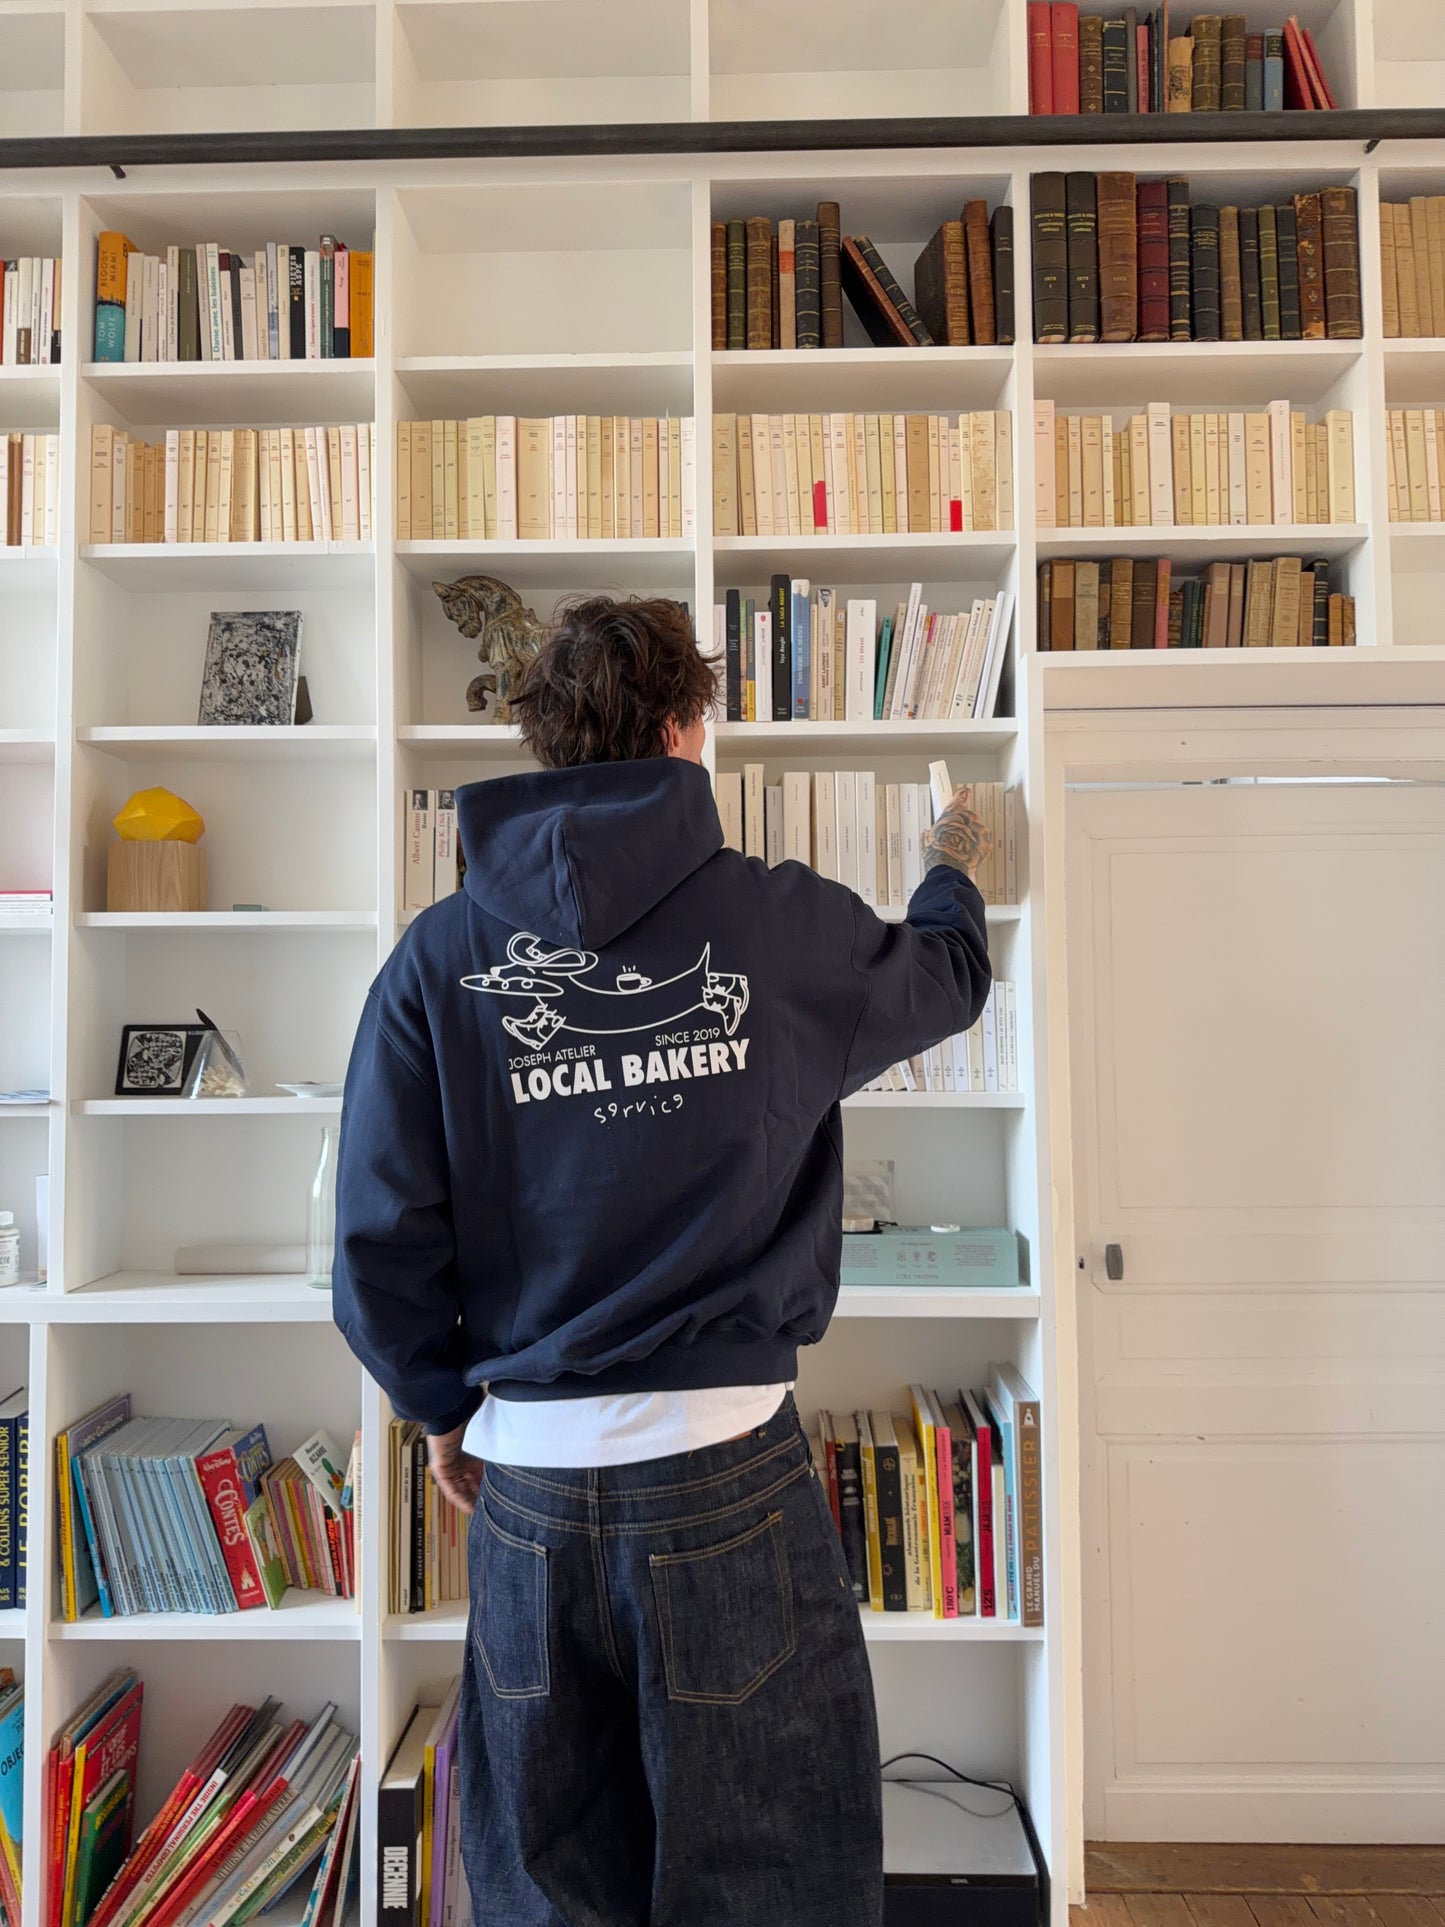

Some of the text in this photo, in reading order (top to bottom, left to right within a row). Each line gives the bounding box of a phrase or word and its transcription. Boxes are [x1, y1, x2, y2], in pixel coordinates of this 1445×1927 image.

[413, 841, 421, 864] Albert
[439, 839, 447, 857] Philip
[509, 1044, 596, 1070] JOSEPH ATELIER
[655, 1027, 720, 1047] SINCE 2019
[510, 1038, 750, 1104] LOCAL BAKERY
[215, 1458, 232, 1469] Disney
[417, 1466, 423, 1475] DE
[0, 1426, 10, 1567] & COLLINS SUPER SENIOR
[214, 1479, 244, 1546] CONTES
[417, 1510, 423, 1518] LE
[1023, 1439, 1039, 1550] PATISSIER
[1032, 1556, 1041, 1611] MANUEL DU
[1027, 1602, 1033, 1612] LE
[143, 1780, 219, 1884] INSIDE THE PERSONAL COMPUTER
[213, 1854, 240, 1883] MYTHES
[235, 1845, 247, 1857] DE
[242, 1835, 255, 1848] LA
[267, 1788, 294, 1819] ANTIQUE
[383, 1847, 408, 1909] DECENNIE
